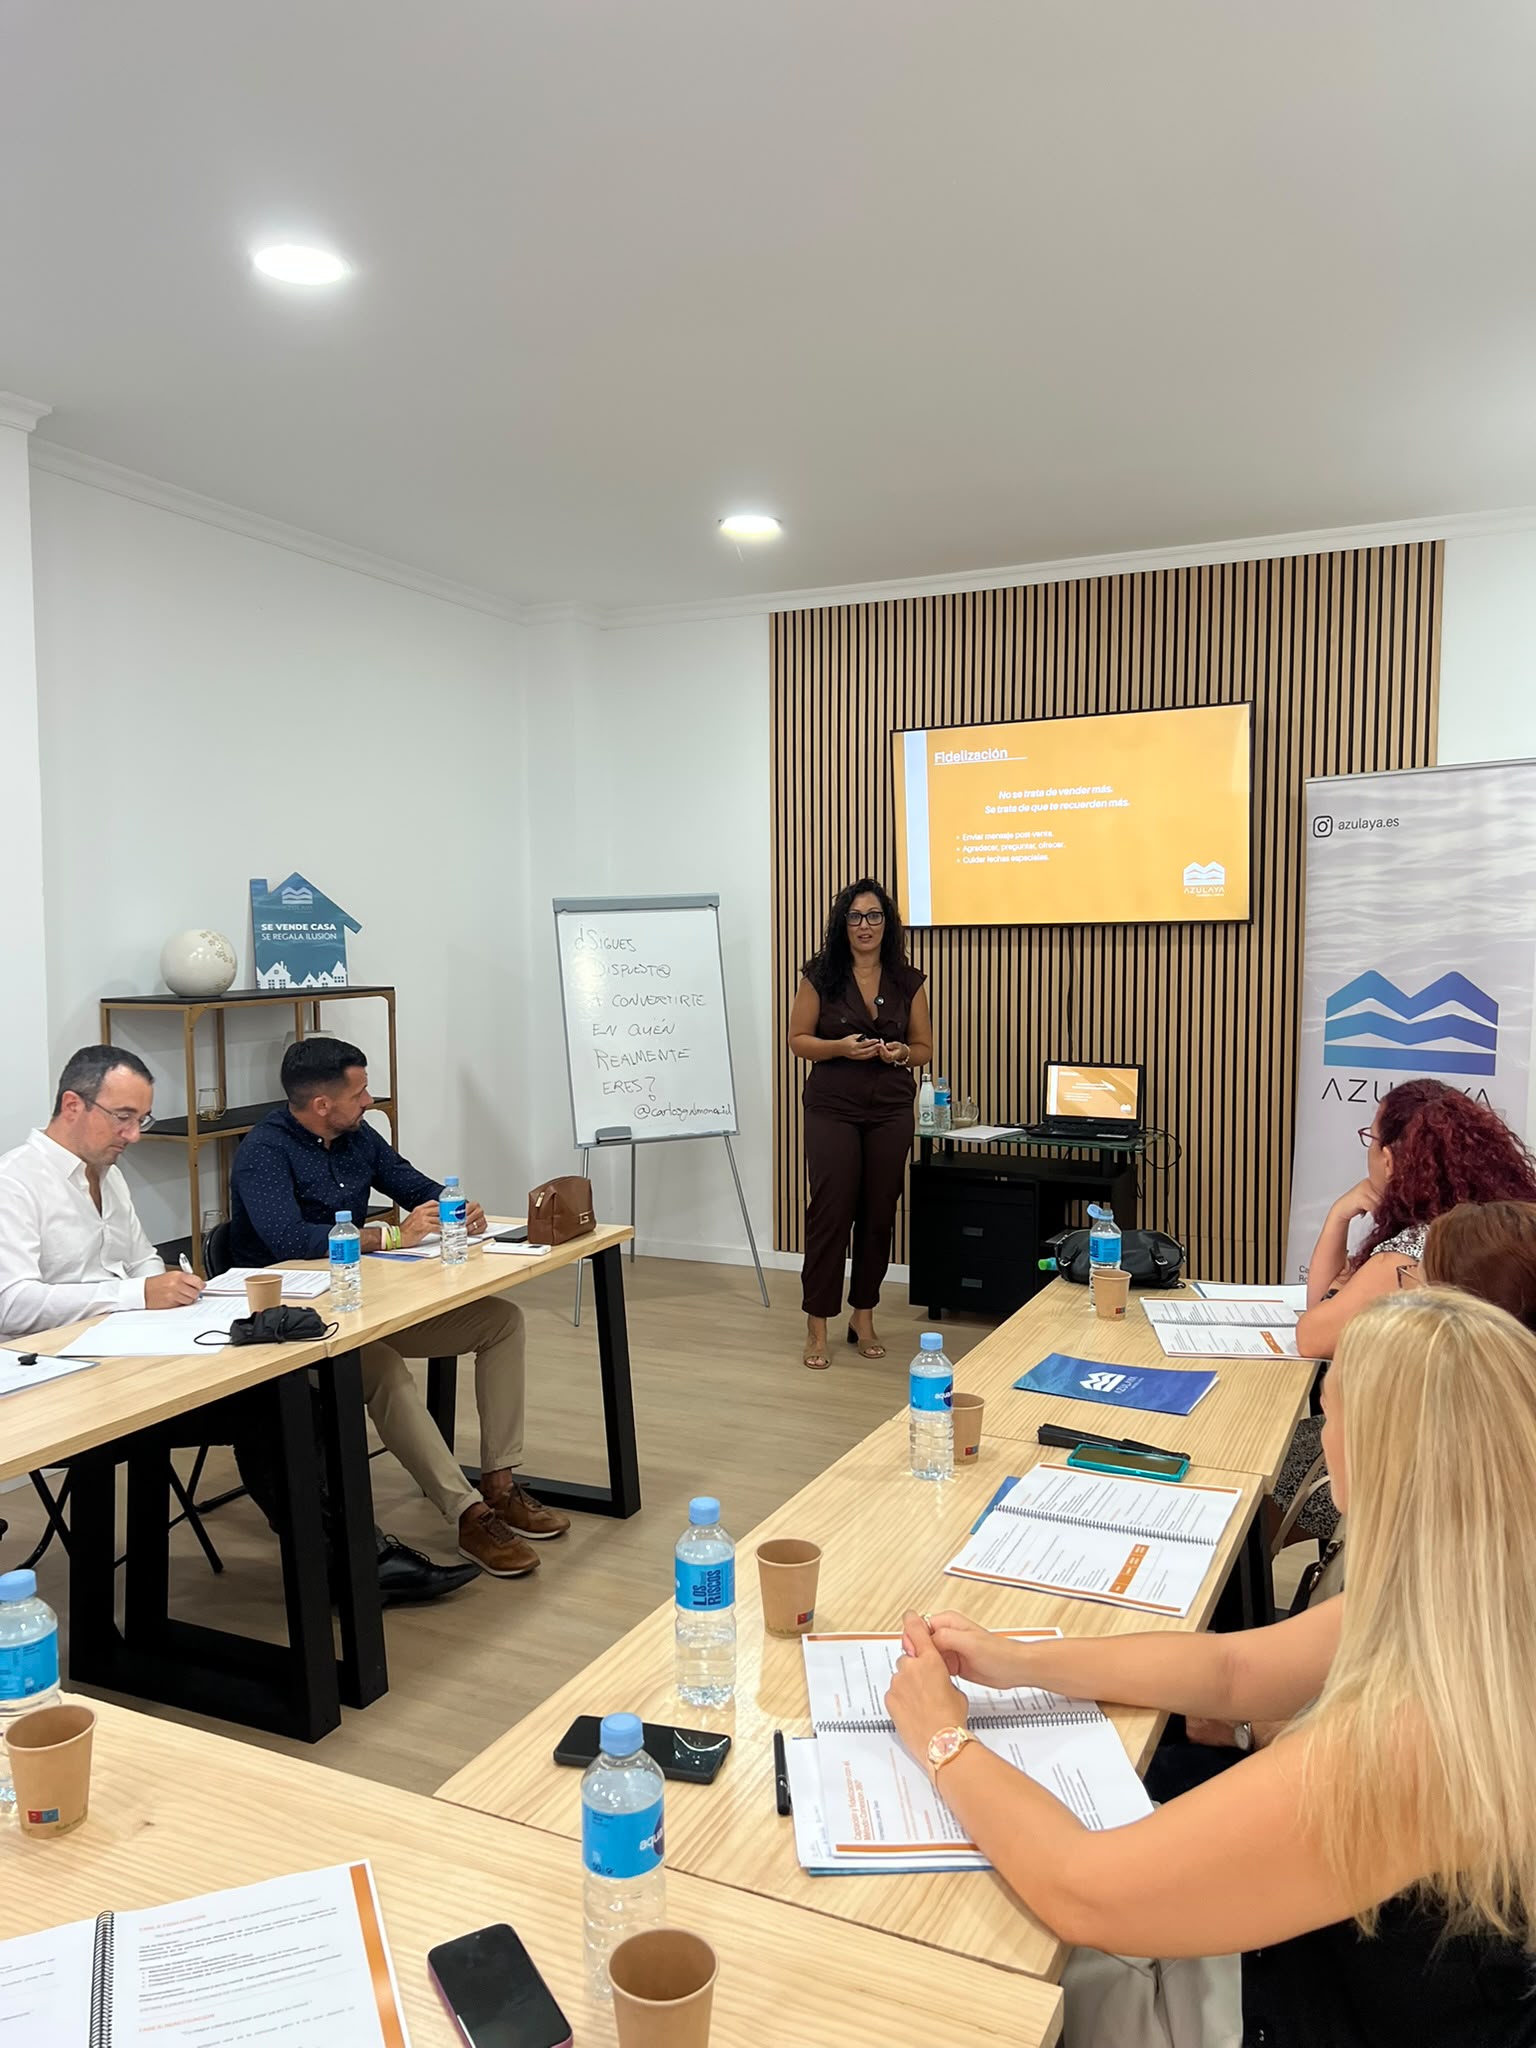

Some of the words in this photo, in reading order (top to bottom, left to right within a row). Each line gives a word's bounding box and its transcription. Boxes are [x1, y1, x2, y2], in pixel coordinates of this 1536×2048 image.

[934, 748, 1008, 763] Fidelización
[999, 791, 1012, 799] No
[1024, 789, 1045, 798] trata
[1045, 788, 1057, 797] de
[1059, 786, 1091, 796] vender
[1091, 785, 1113, 794] más.
[985, 805, 997, 814] Se
[997, 804, 1018, 813] trata
[1018, 803, 1030, 812] de
[1031, 803, 1049, 813] que
[1049, 803, 1059, 811] te
[1059, 799, 1107, 810] recuerden
[1108, 798, 1130, 808] más.
[1338, 817, 1400, 831] azulaya.es
[962, 833, 983, 841] Enviar
[985, 831, 1013, 841] mensaje
[962, 856, 985, 864] Cuidar
[1184, 886, 1225, 894] AZULAYA
[310, 923, 337, 931] CASA
[272, 932, 304, 940] REGALA
[592, 1023, 618, 1037] EN
[593, 1048, 692, 1071] REALMENTE
[706, 1569, 721, 1606] RISCOS
[692, 1584, 707, 1606] LOS
